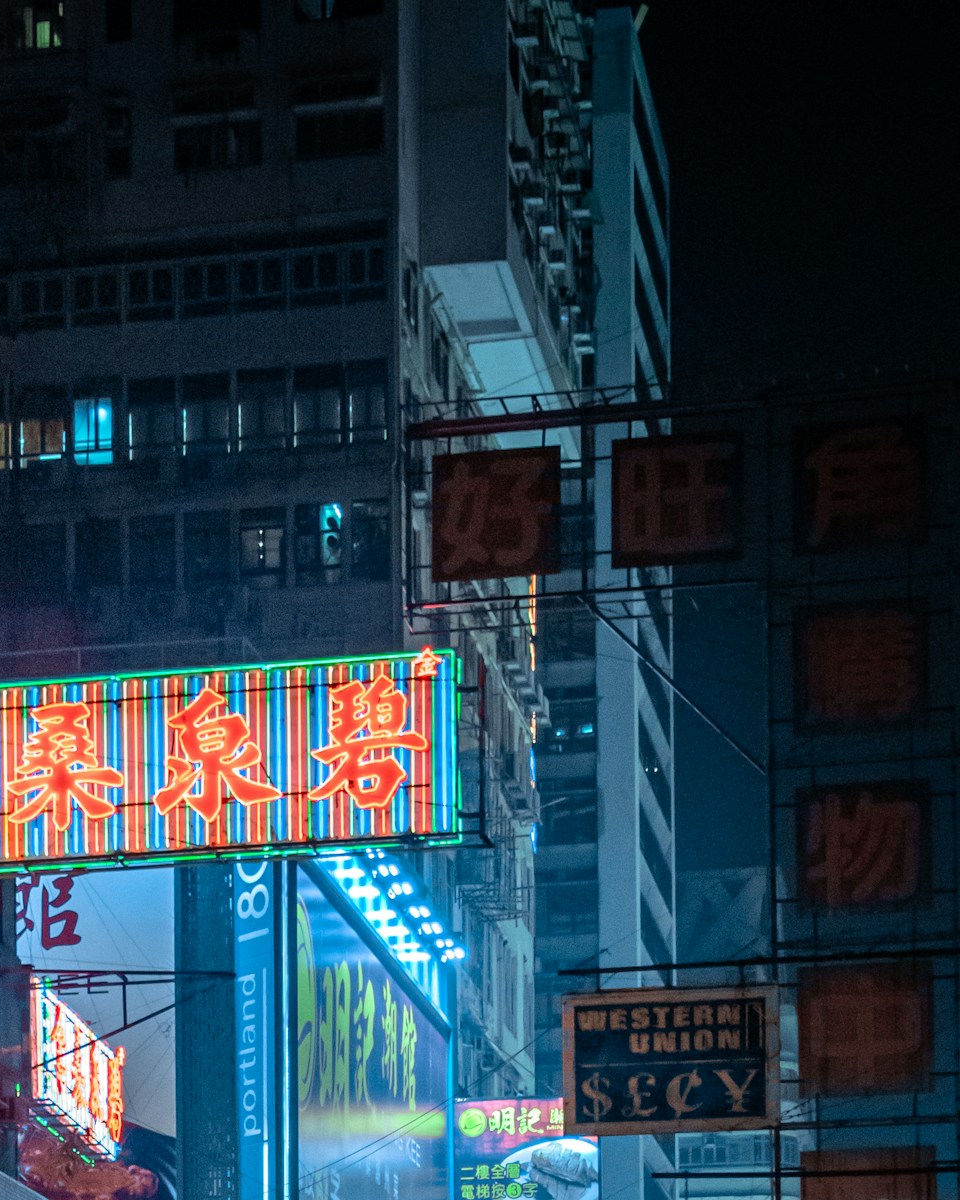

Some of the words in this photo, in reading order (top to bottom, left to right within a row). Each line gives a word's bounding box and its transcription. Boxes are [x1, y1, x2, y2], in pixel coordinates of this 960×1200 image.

[578, 1004, 742, 1031] WESTERN
[629, 1028, 742, 1054] UNION
[238, 974, 261, 1137] portland
[461, 1163, 521, 1180] 二樓全層
